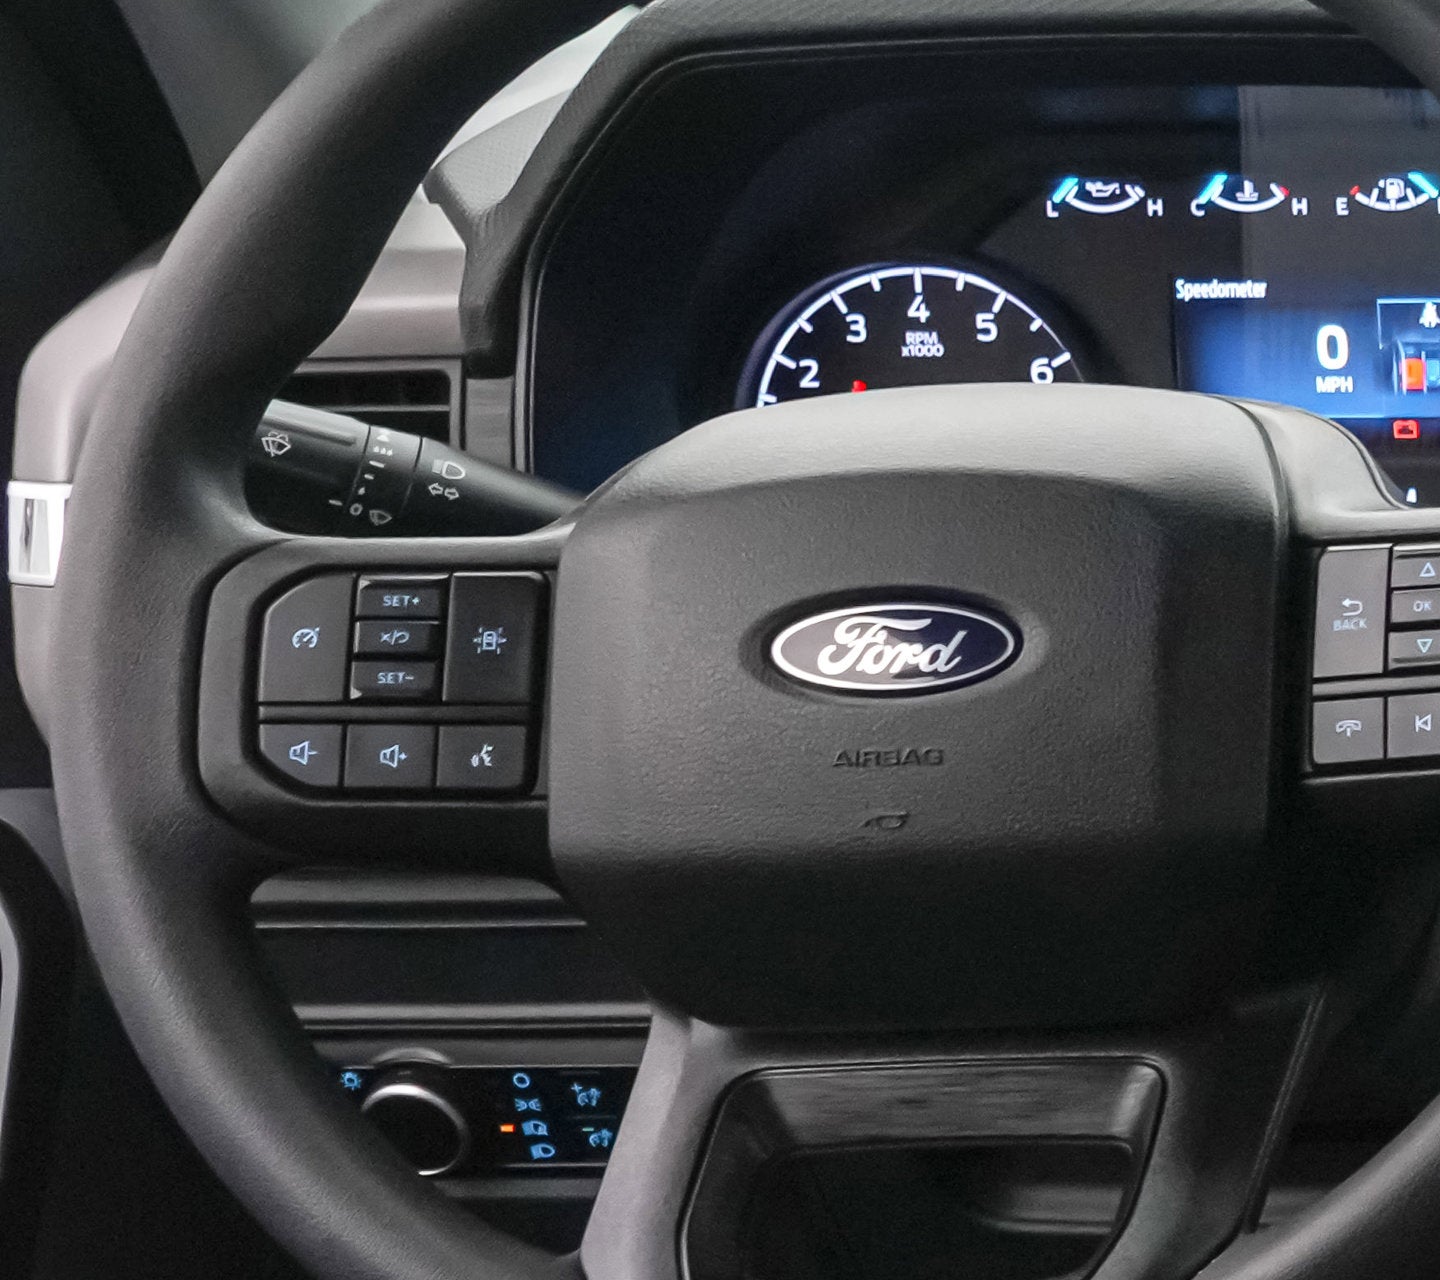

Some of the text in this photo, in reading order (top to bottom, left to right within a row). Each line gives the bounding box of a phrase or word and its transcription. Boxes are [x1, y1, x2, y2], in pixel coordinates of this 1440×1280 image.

[1046, 200, 1059, 218] L
[1147, 199, 1163, 217] H
[1191, 200, 1205, 217] C
[1292, 199, 1308, 216] H
[1337, 198, 1349, 215] E
[1175, 278, 1268, 301] Speedometer
[907, 294, 930, 323] 4
[846, 314, 867, 343] 3
[975, 313, 998, 342] 5
[905, 331, 939, 345] RPM
[1316, 324, 1349, 370] 0
[901, 344, 945, 358] x1000
[799, 359, 821, 388] 2
[1030, 357, 1054, 385] 6
[1316, 376, 1354, 393] MPH
[1412, 599, 1433, 612] OK
[1332, 617, 1368, 632] BACK
[817, 615, 968, 676] Ford
[833, 748, 945, 767] AIRBAG
